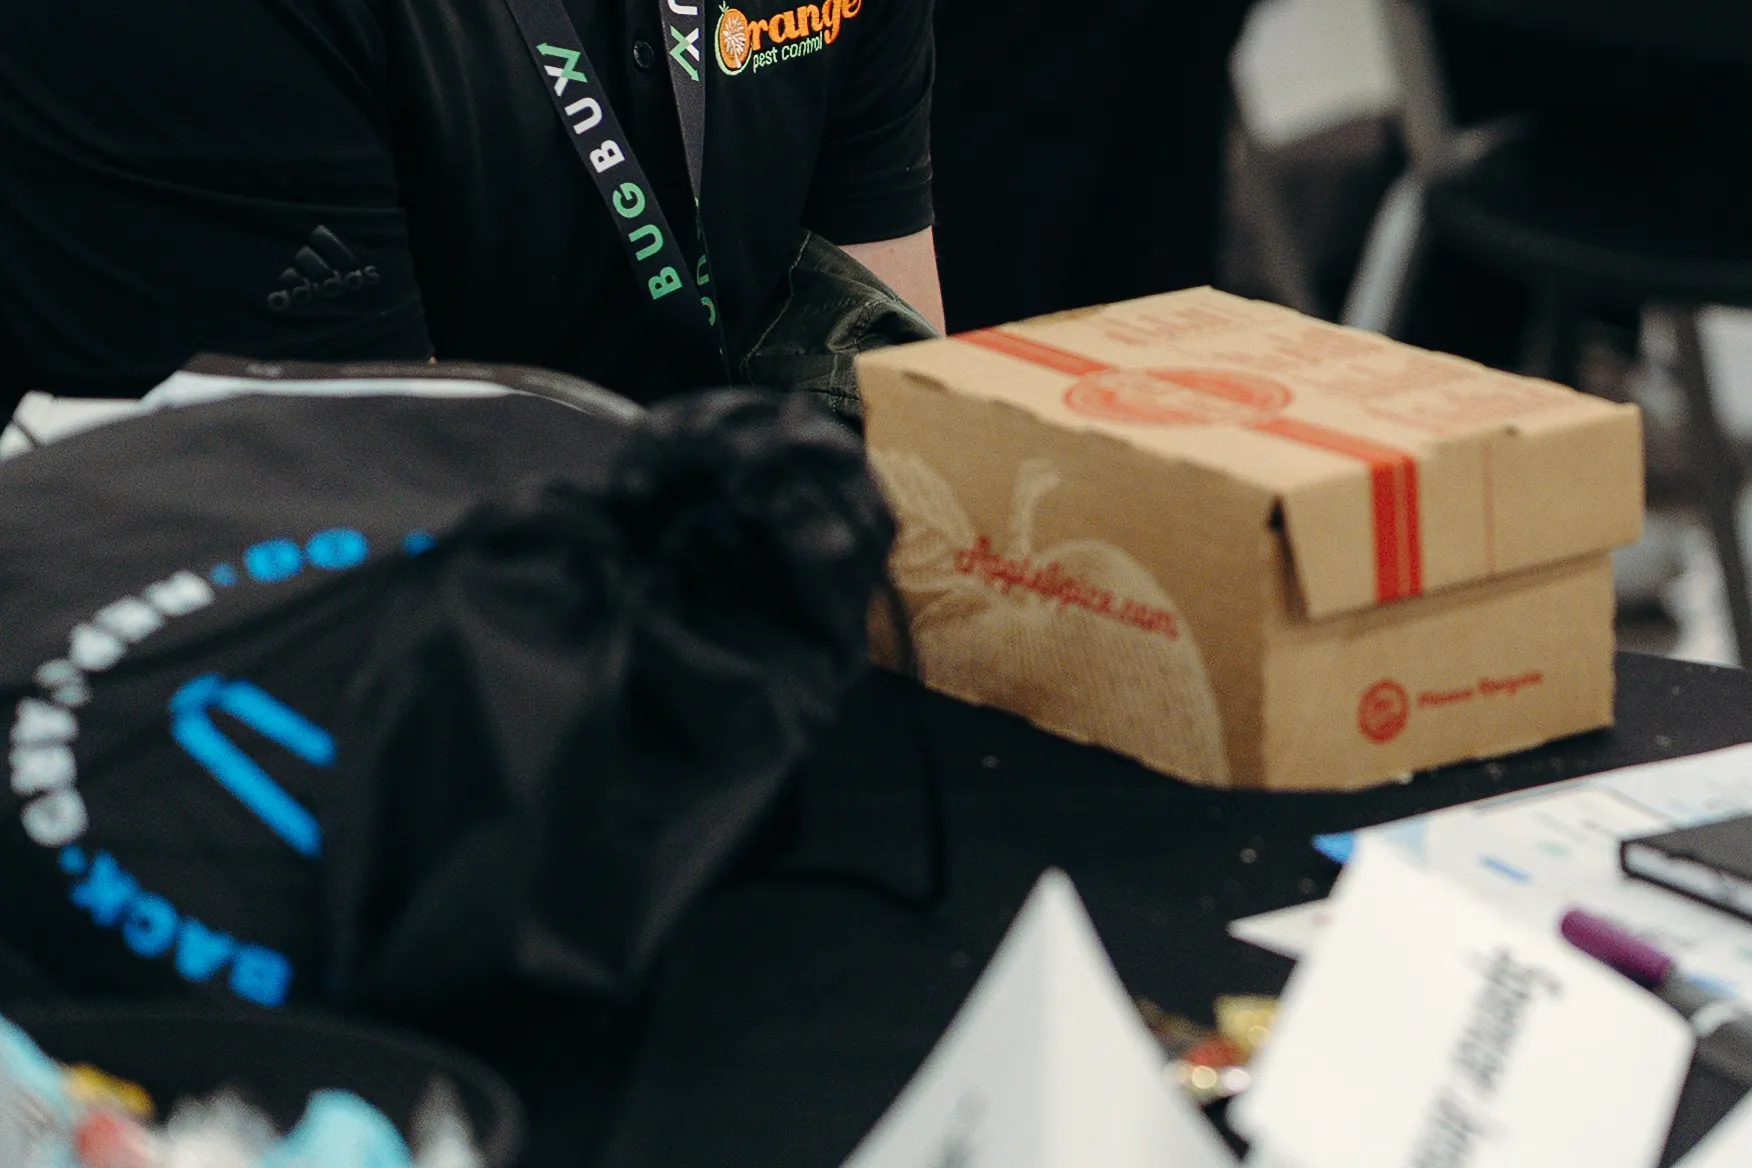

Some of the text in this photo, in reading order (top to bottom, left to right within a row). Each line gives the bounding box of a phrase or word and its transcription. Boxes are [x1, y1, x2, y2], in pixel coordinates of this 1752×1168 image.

[753, 30, 823, 74] pest control
[267, 264, 380, 312] adidas
